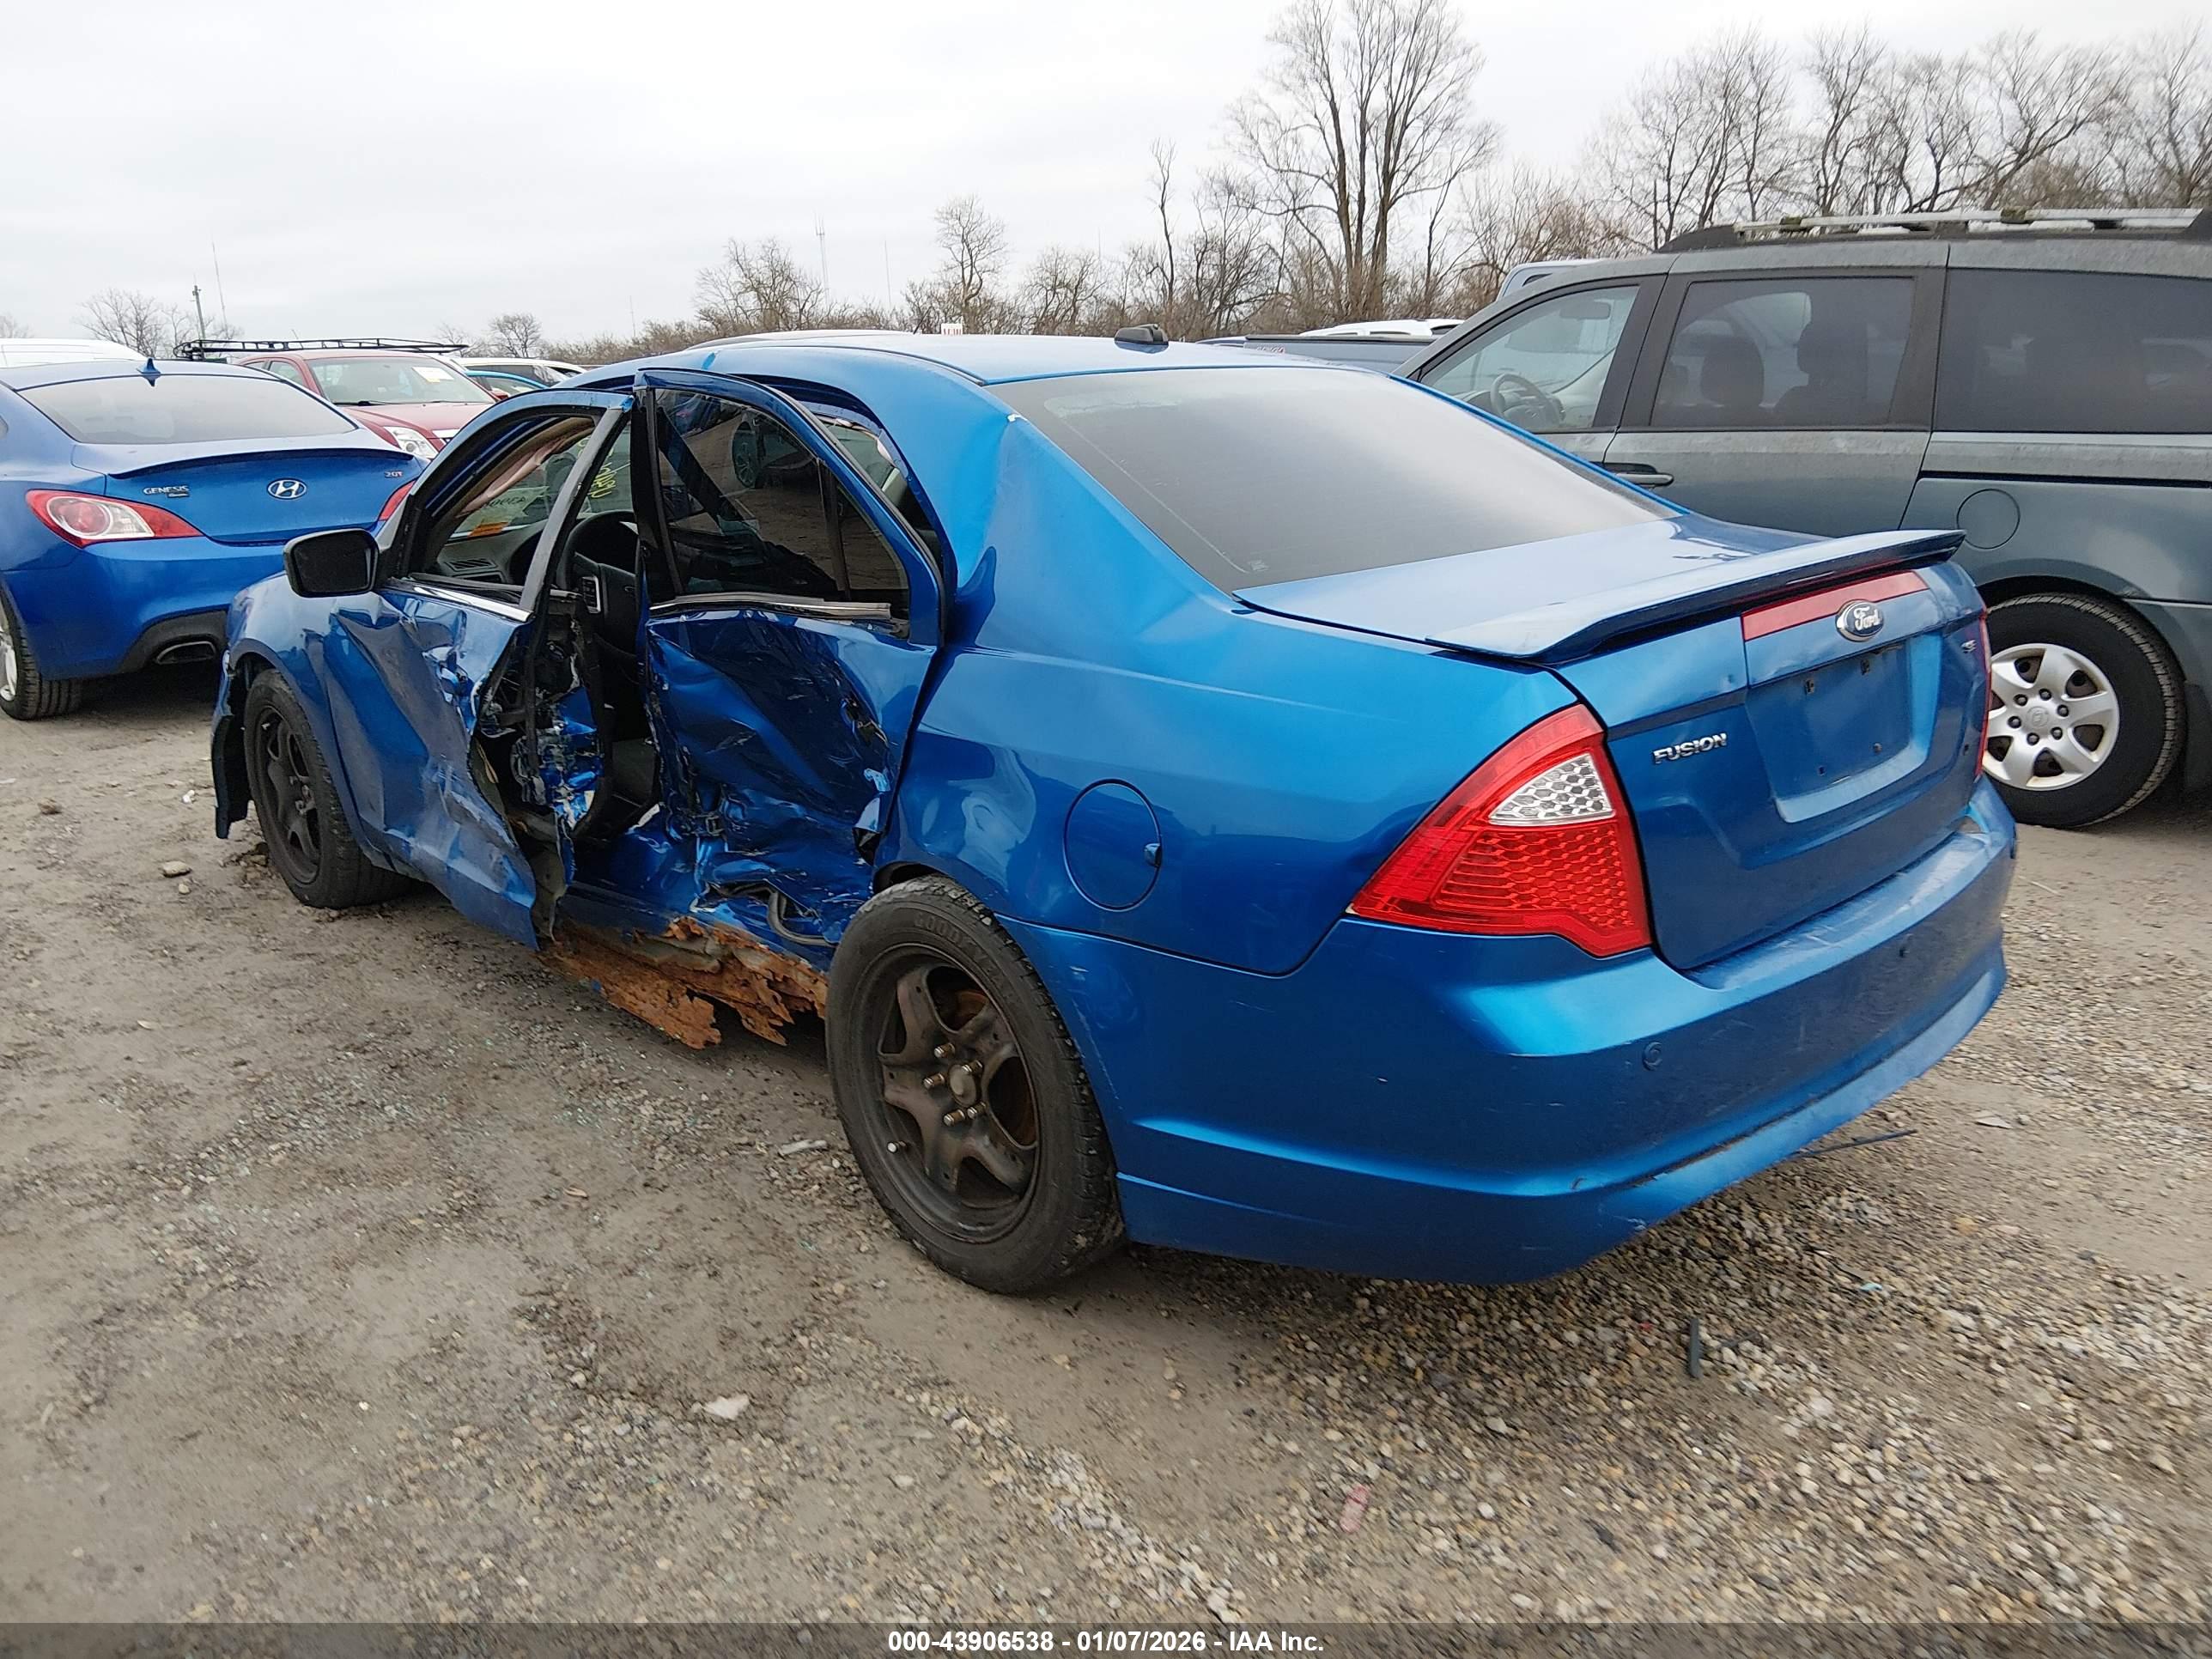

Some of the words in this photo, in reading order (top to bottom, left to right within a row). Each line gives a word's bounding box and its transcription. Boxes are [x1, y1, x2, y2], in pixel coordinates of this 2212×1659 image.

[143, 485, 190, 495] GENESIS
[1853, 605, 1881, 631] Ford
[1652, 732, 1728, 764] FUSION
